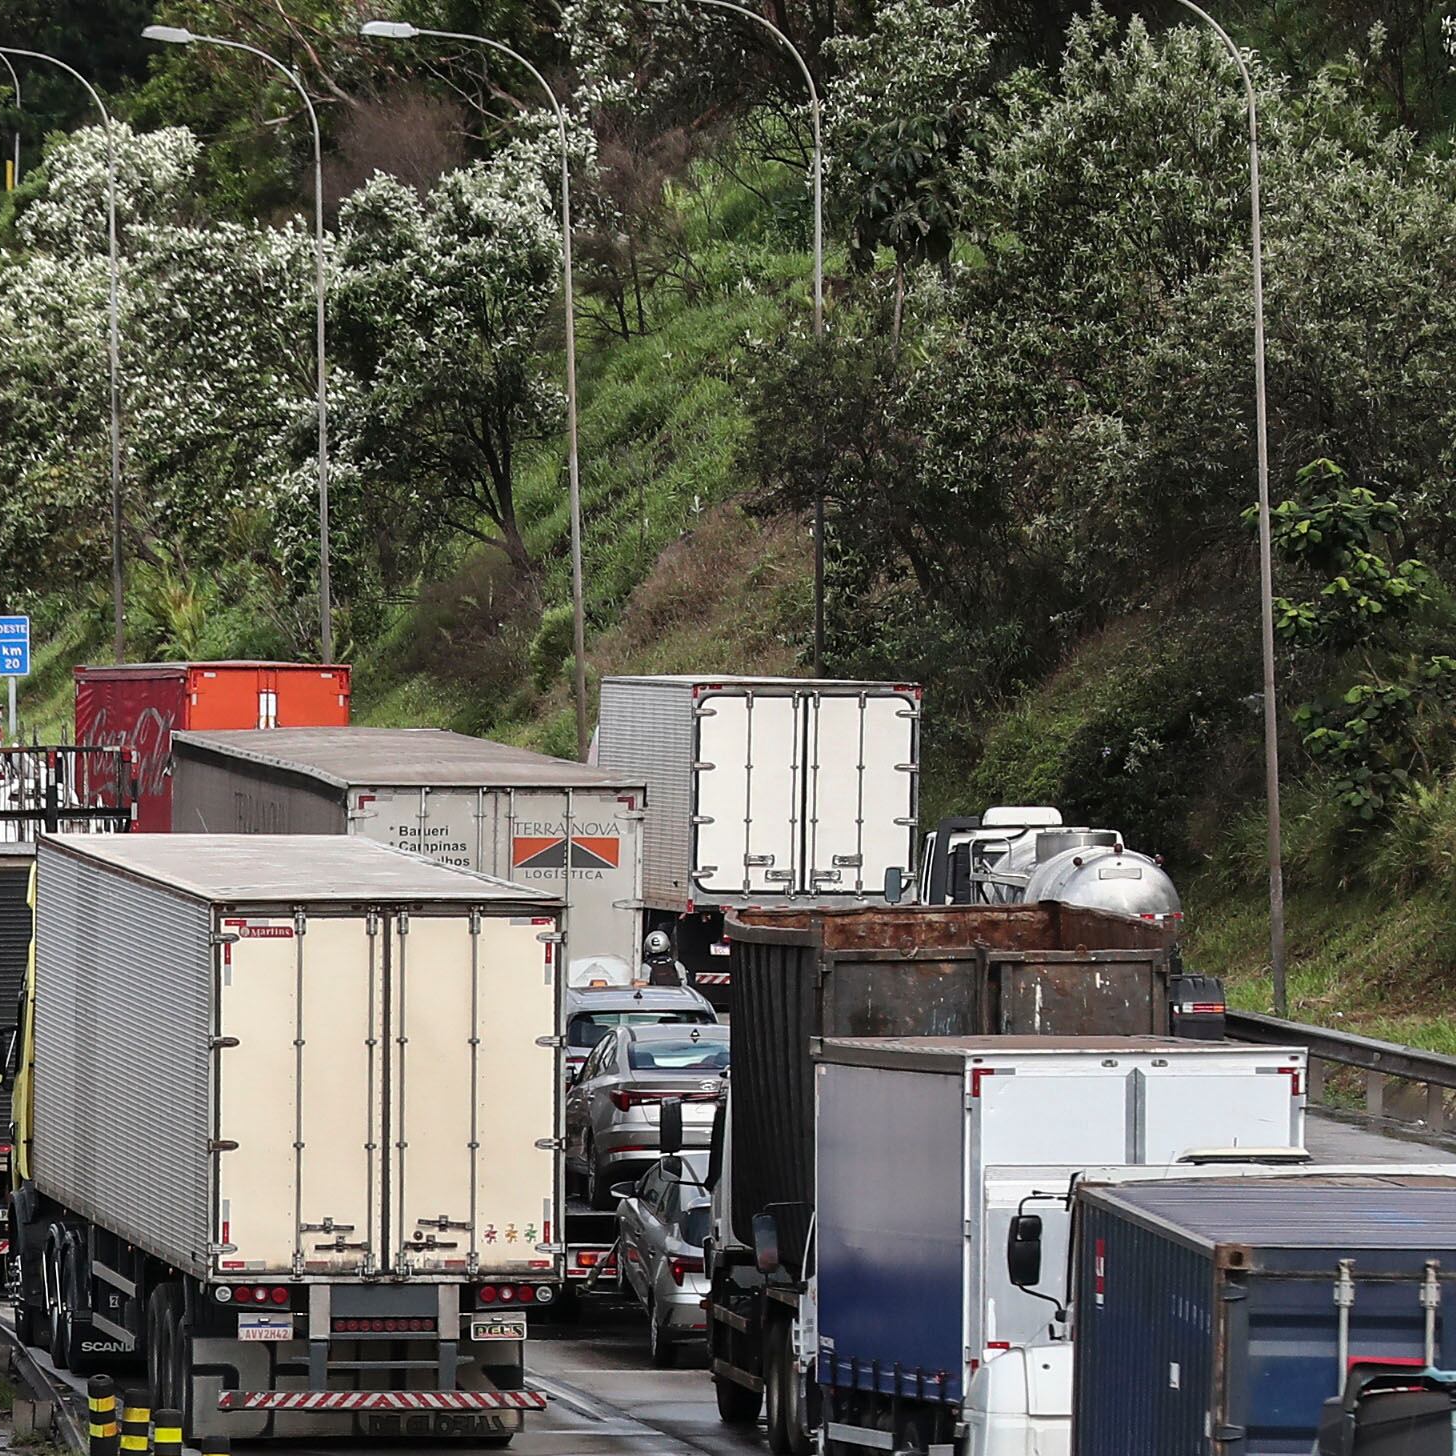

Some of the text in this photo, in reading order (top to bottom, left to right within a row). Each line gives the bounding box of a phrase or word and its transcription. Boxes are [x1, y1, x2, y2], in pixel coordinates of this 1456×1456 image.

[2, 645, 23, 656] km
[5, 658, 20, 669] 20
[398, 824, 449, 837] Barueri
[513, 821, 620, 837] TERRA NOVA
[525, 866, 604, 881] LOGÍSTICA
[251, 926, 291, 938] Martins
[651, 937, 661, 947] e
